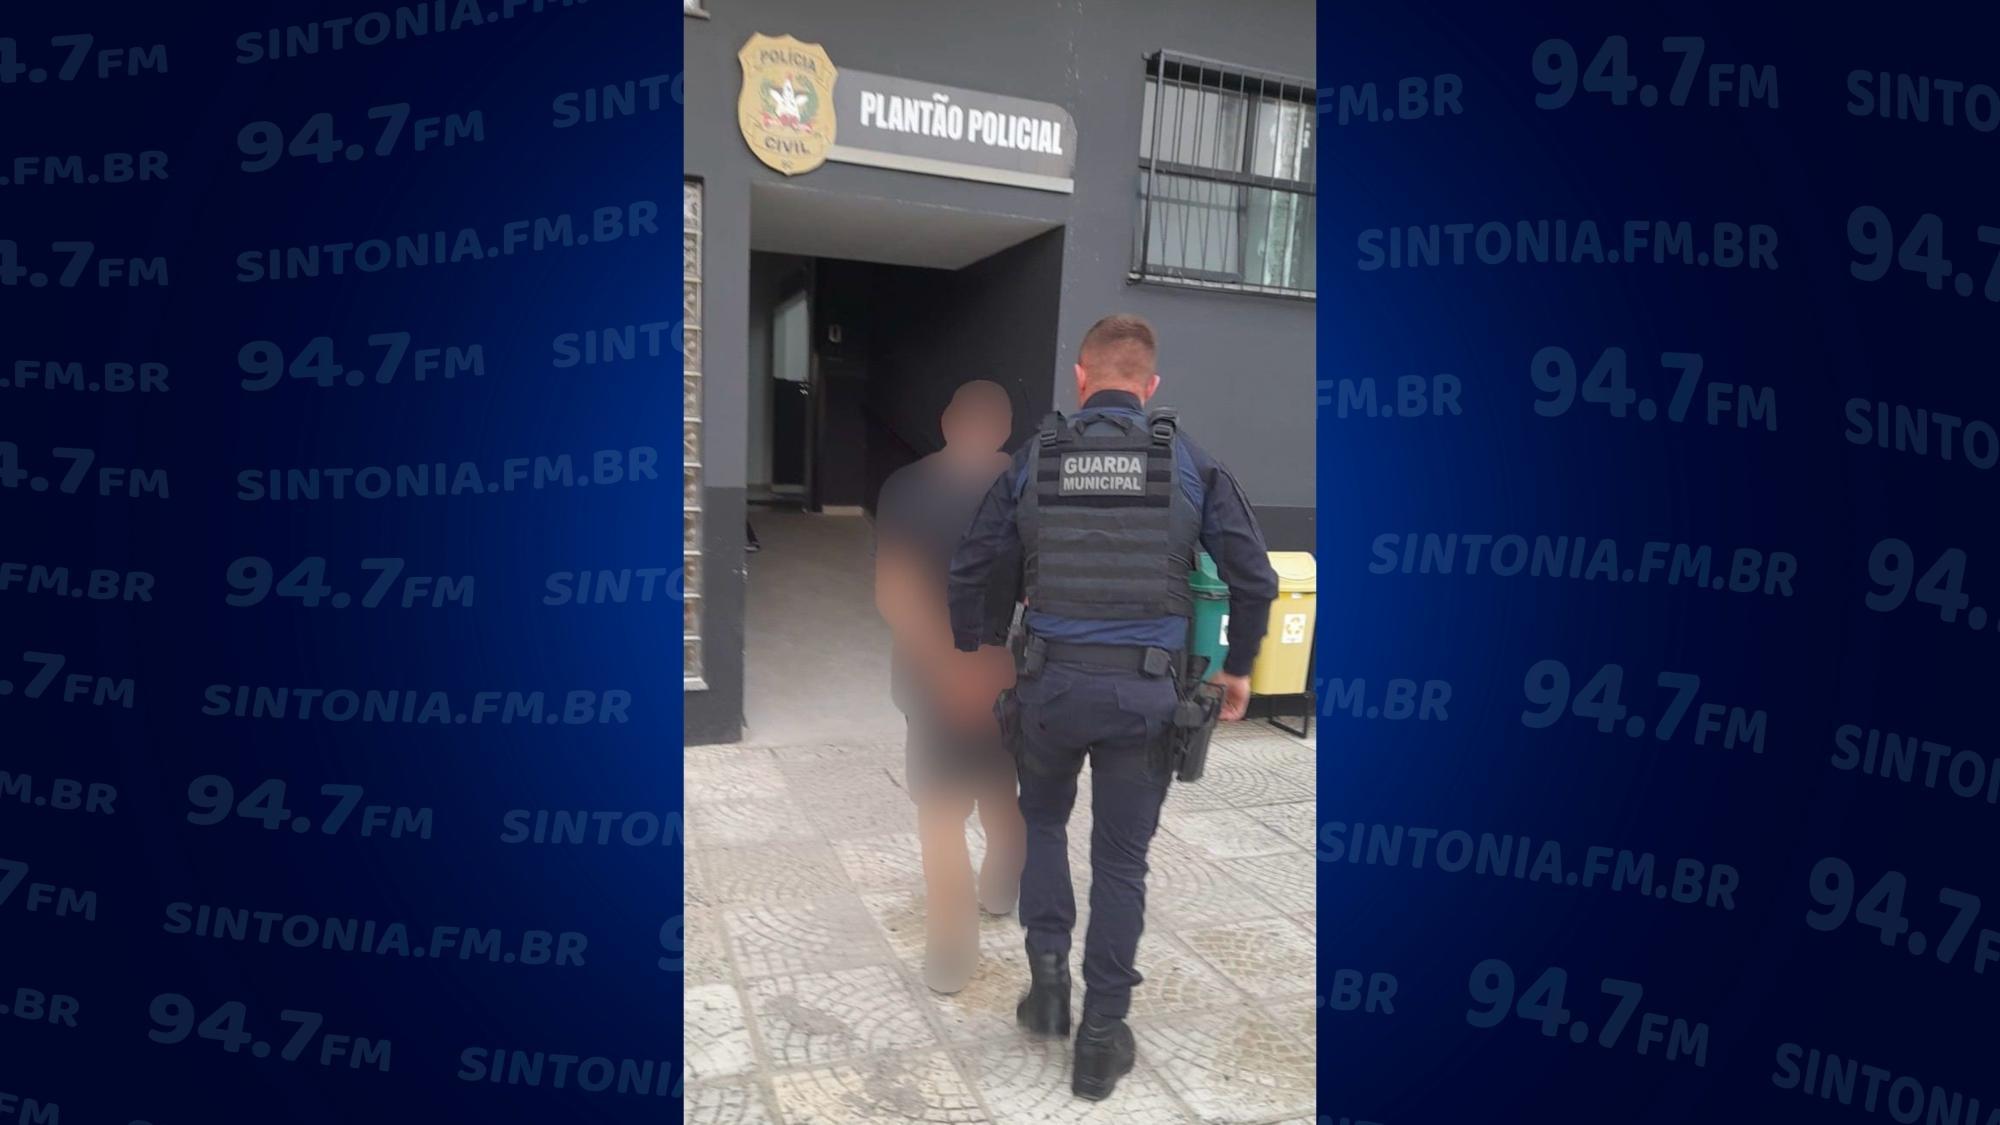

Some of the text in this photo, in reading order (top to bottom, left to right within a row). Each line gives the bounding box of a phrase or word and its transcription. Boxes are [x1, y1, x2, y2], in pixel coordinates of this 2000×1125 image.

[860, 90, 964, 140] PLANTÃO
[968, 108, 1063, 155] POLICIAL
[764, 135, 811, 154] CIVIL
[1064, 456, 1143, 474] GUARDA
[1063, 476, 1142, 491] MUNICIPAL
